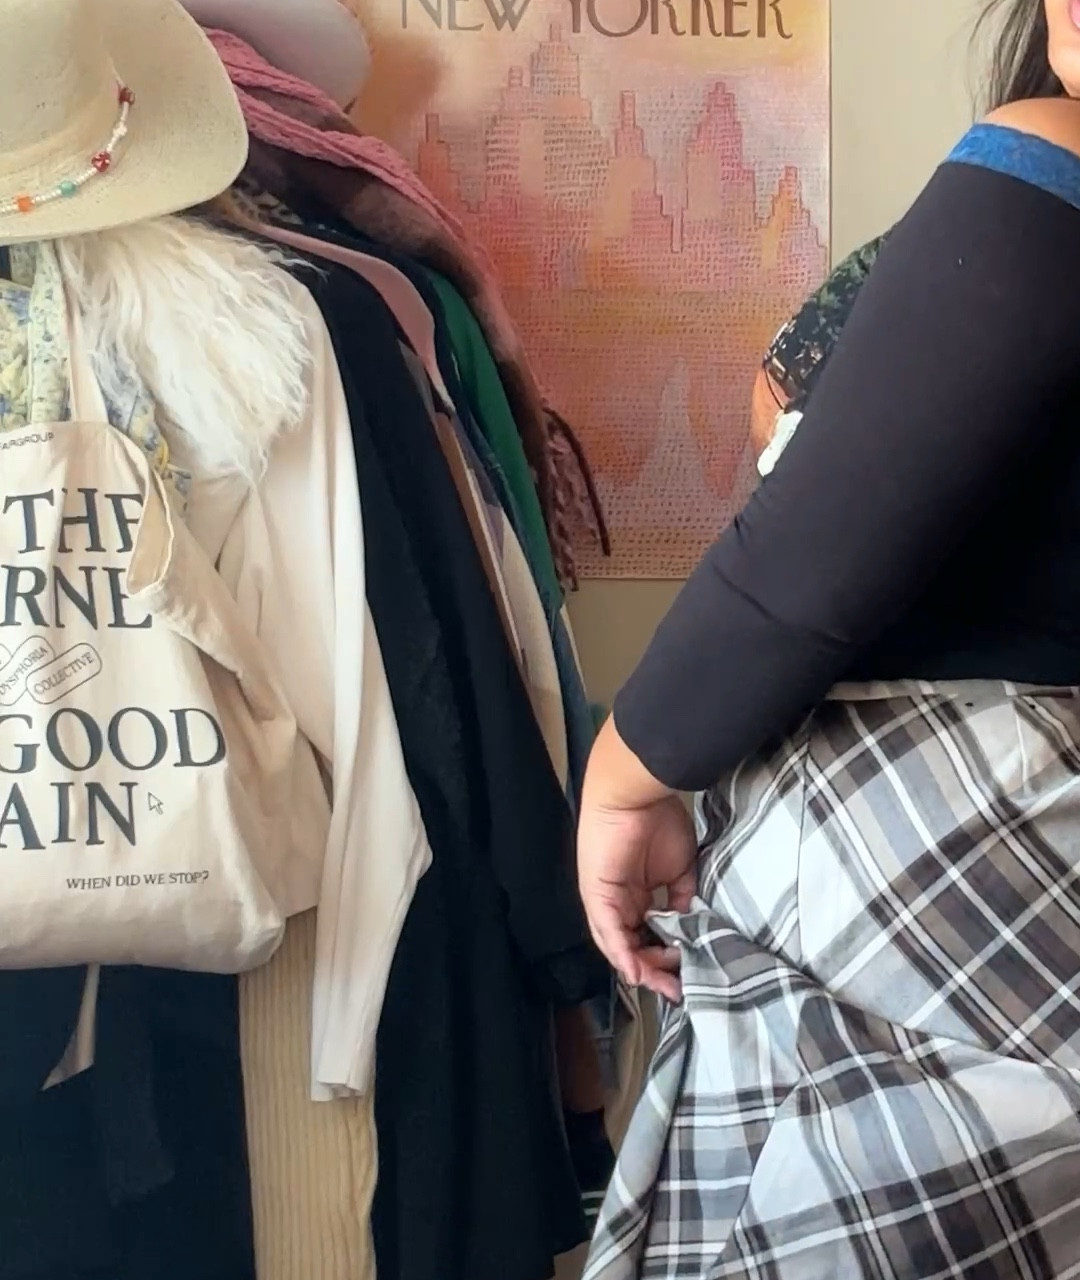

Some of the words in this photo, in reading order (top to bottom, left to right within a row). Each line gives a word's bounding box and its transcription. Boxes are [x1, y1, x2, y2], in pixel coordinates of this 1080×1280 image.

[3, 488, 144, 553] THE
[33, 651, 94, 695] COLLECTIVE
[0, 707, 227, 774] GOOD
[0, 782, 139, 850] AIN
[66, 876, 112, 890] WHEN
[115, 875, 141, 887] DID
[143, 873, 166, 885] WE
[168, 870, 210, 884] STOP?
